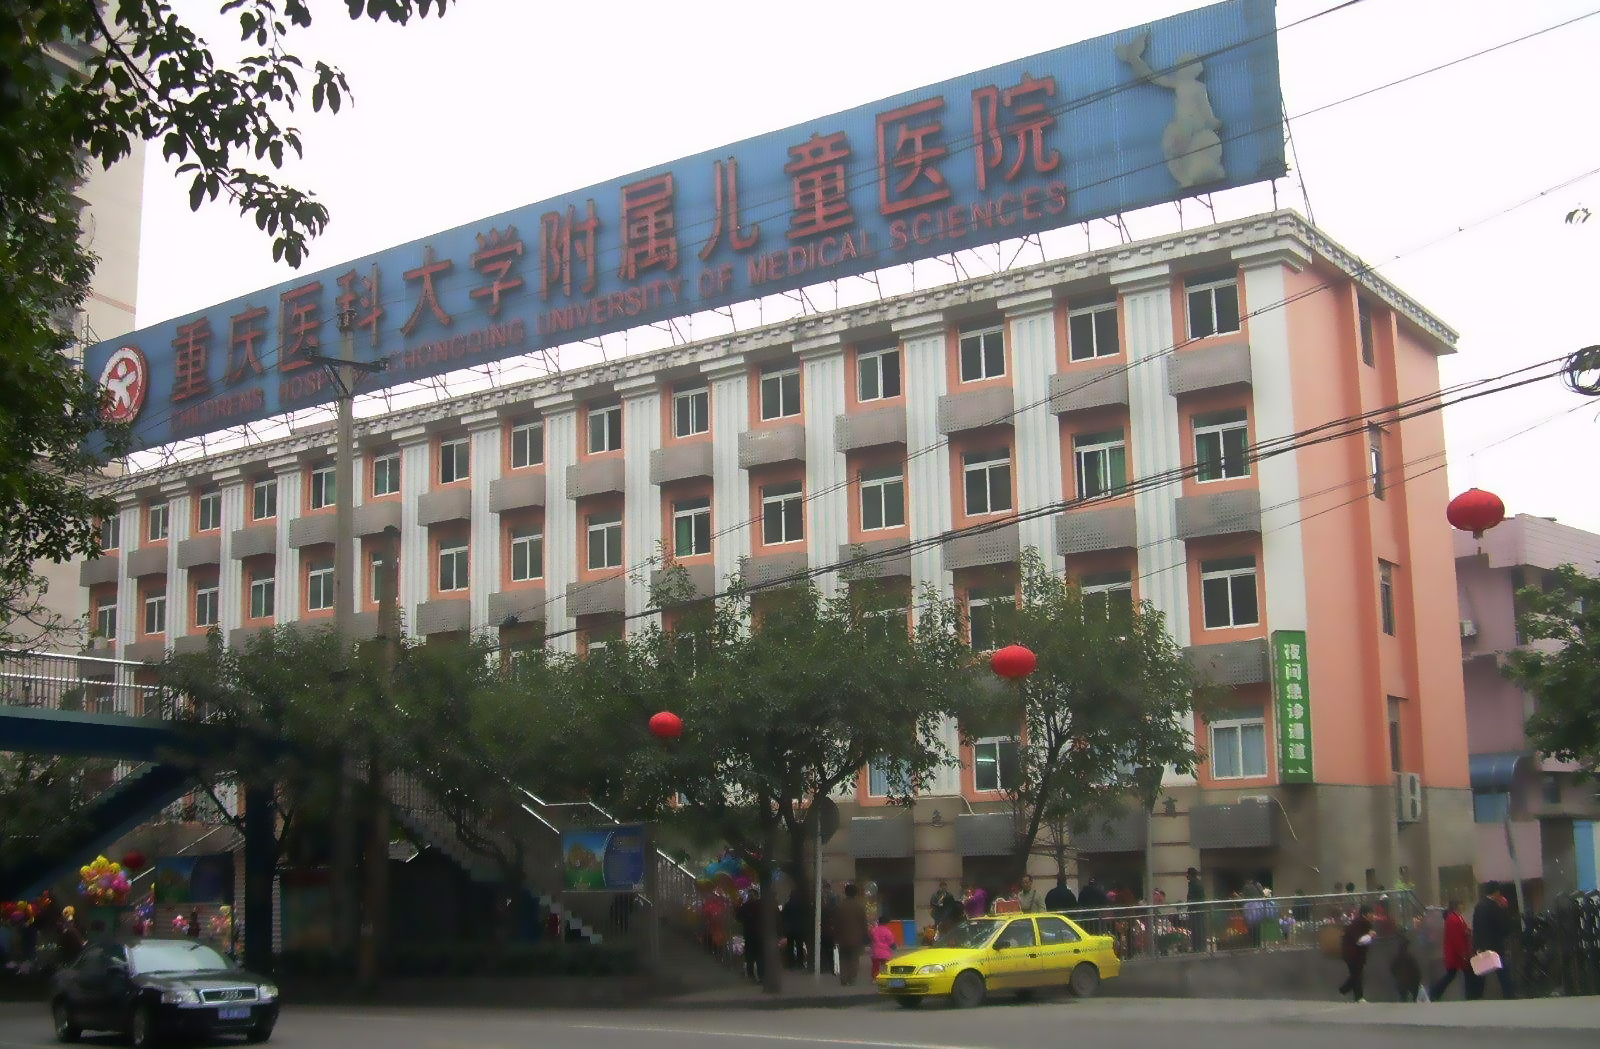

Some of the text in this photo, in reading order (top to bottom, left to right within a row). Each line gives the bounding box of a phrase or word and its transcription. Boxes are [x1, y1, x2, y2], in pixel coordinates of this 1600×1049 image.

[170, 71, 1060, 401] 重庆医科大学附属儿童医院
[535, 275, 687, 336] UNIVERSITY
[697, 264, 733, 298] OF
[747, 229, 875, 287] MEDICAL
[889, 180, 1067, 249] SCIENCES
